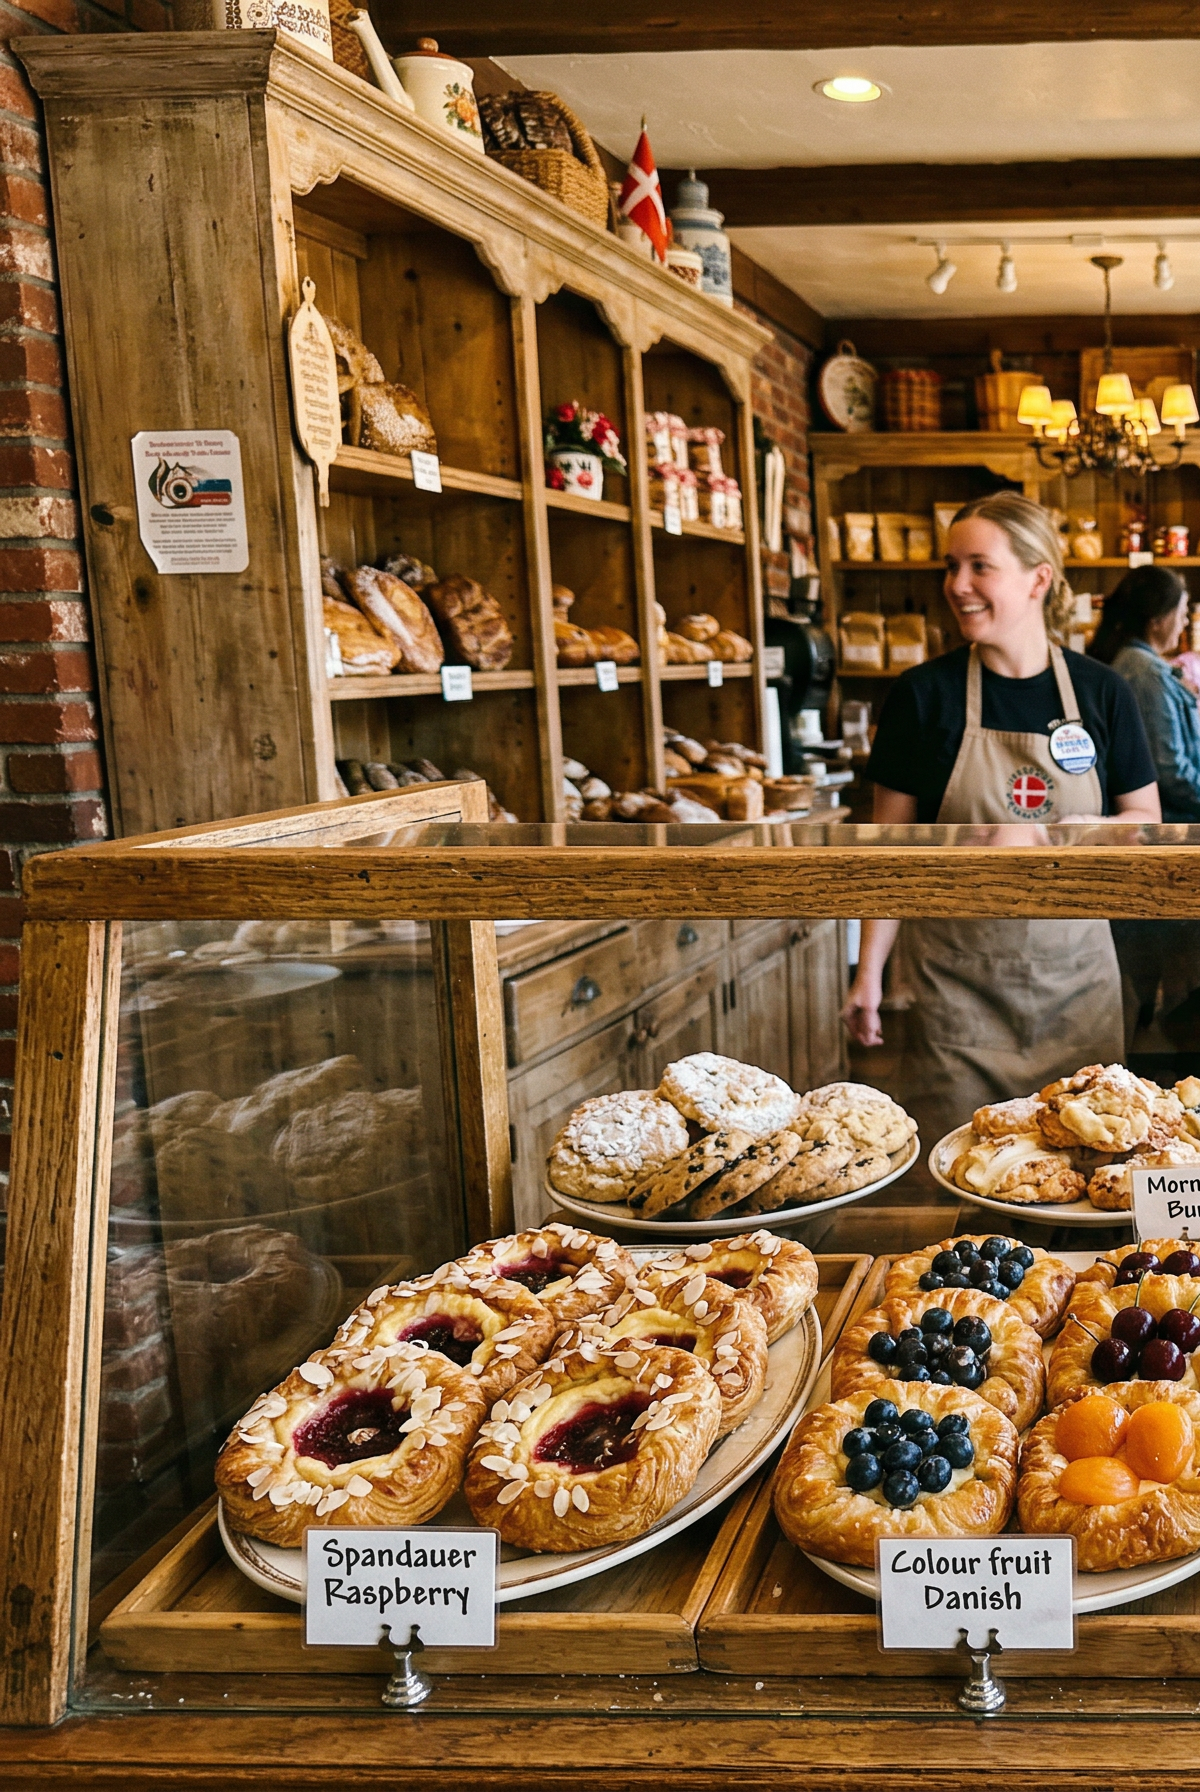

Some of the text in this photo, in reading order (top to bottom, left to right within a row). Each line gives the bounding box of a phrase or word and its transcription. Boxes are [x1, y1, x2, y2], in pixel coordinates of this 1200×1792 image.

[323, 1538, 477, 1576] Spandauer
[891, 1546, 1052, 1576] Colour fruit
[324, 1577, 470, 1615] Raspberry
[924, 1582, 1022, 1610] Danish
